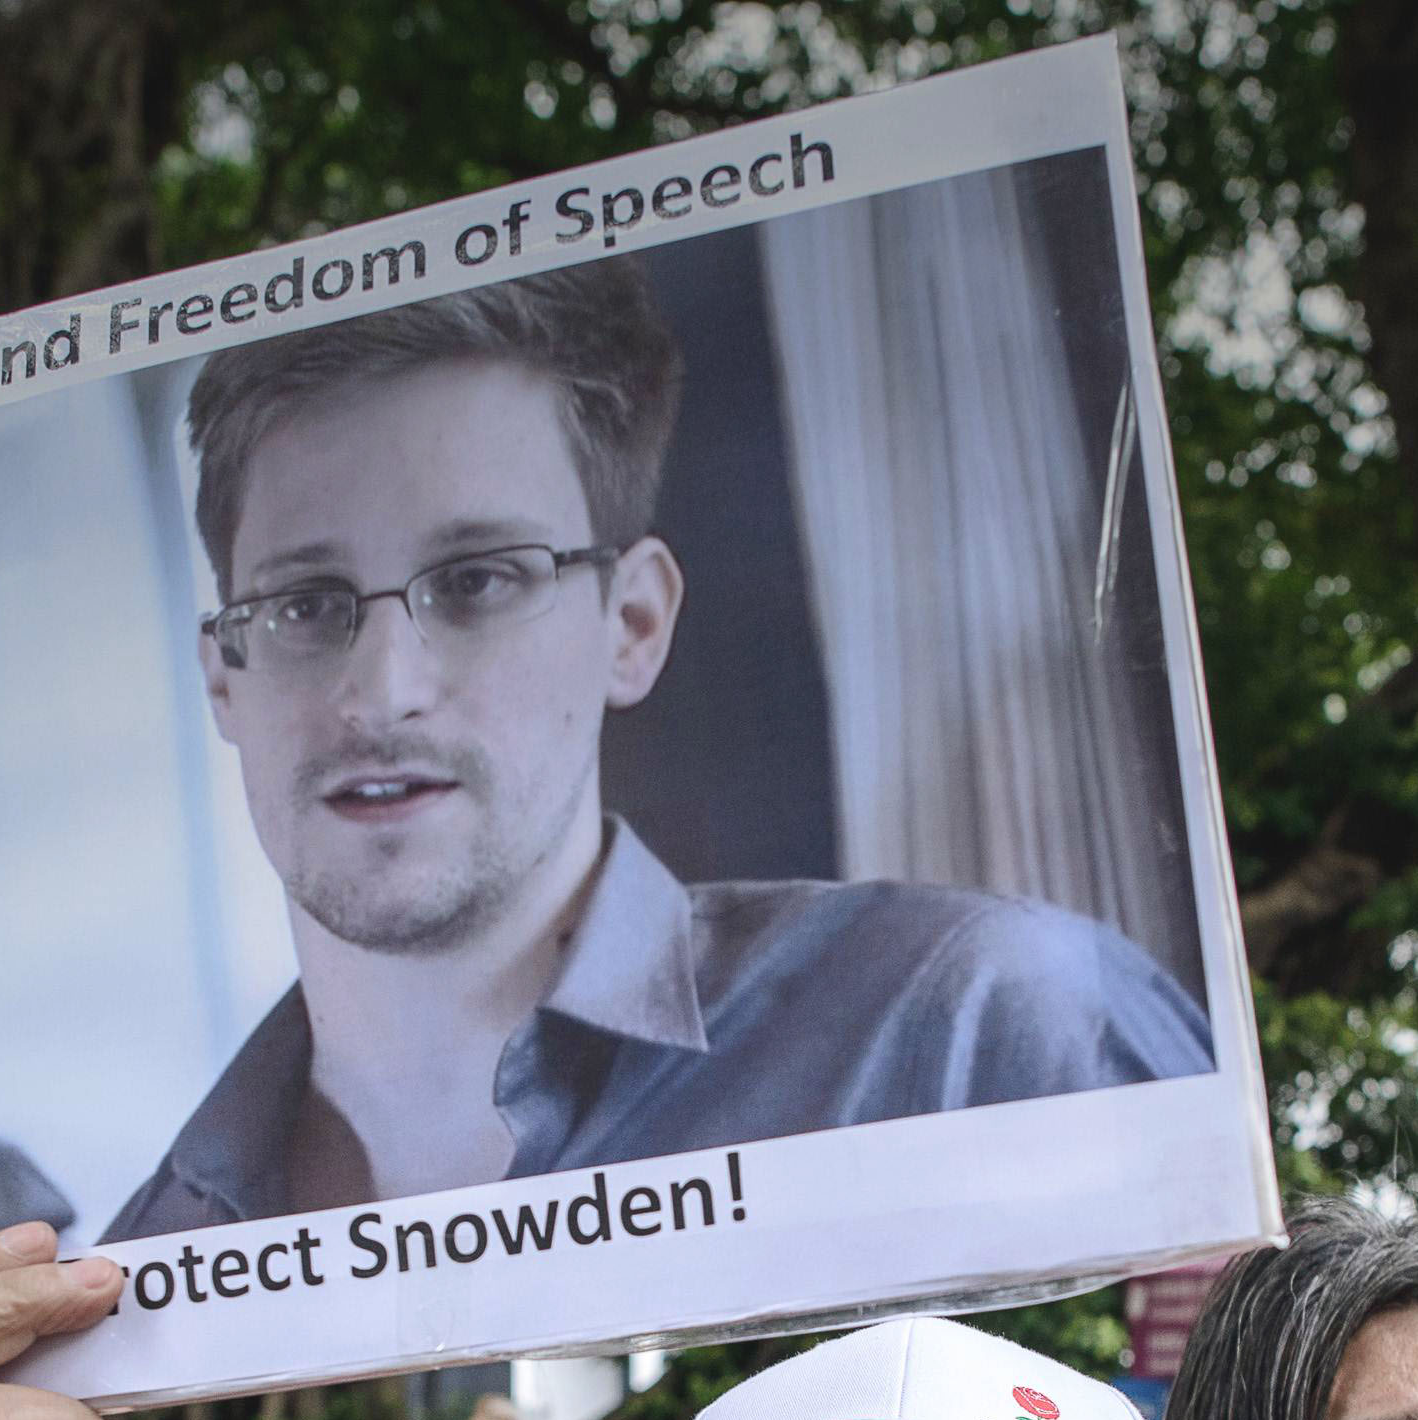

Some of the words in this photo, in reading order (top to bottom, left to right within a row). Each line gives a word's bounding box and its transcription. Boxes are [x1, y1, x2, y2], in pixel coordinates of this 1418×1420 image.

[109, 239, 427, 355] Freedom
[455, 199, 532, 267] of
[555, 132, 835, 249] Speech
[57, 1226, 324, 1316] otect
[349, 1151, 749, 1280] Snowden!
